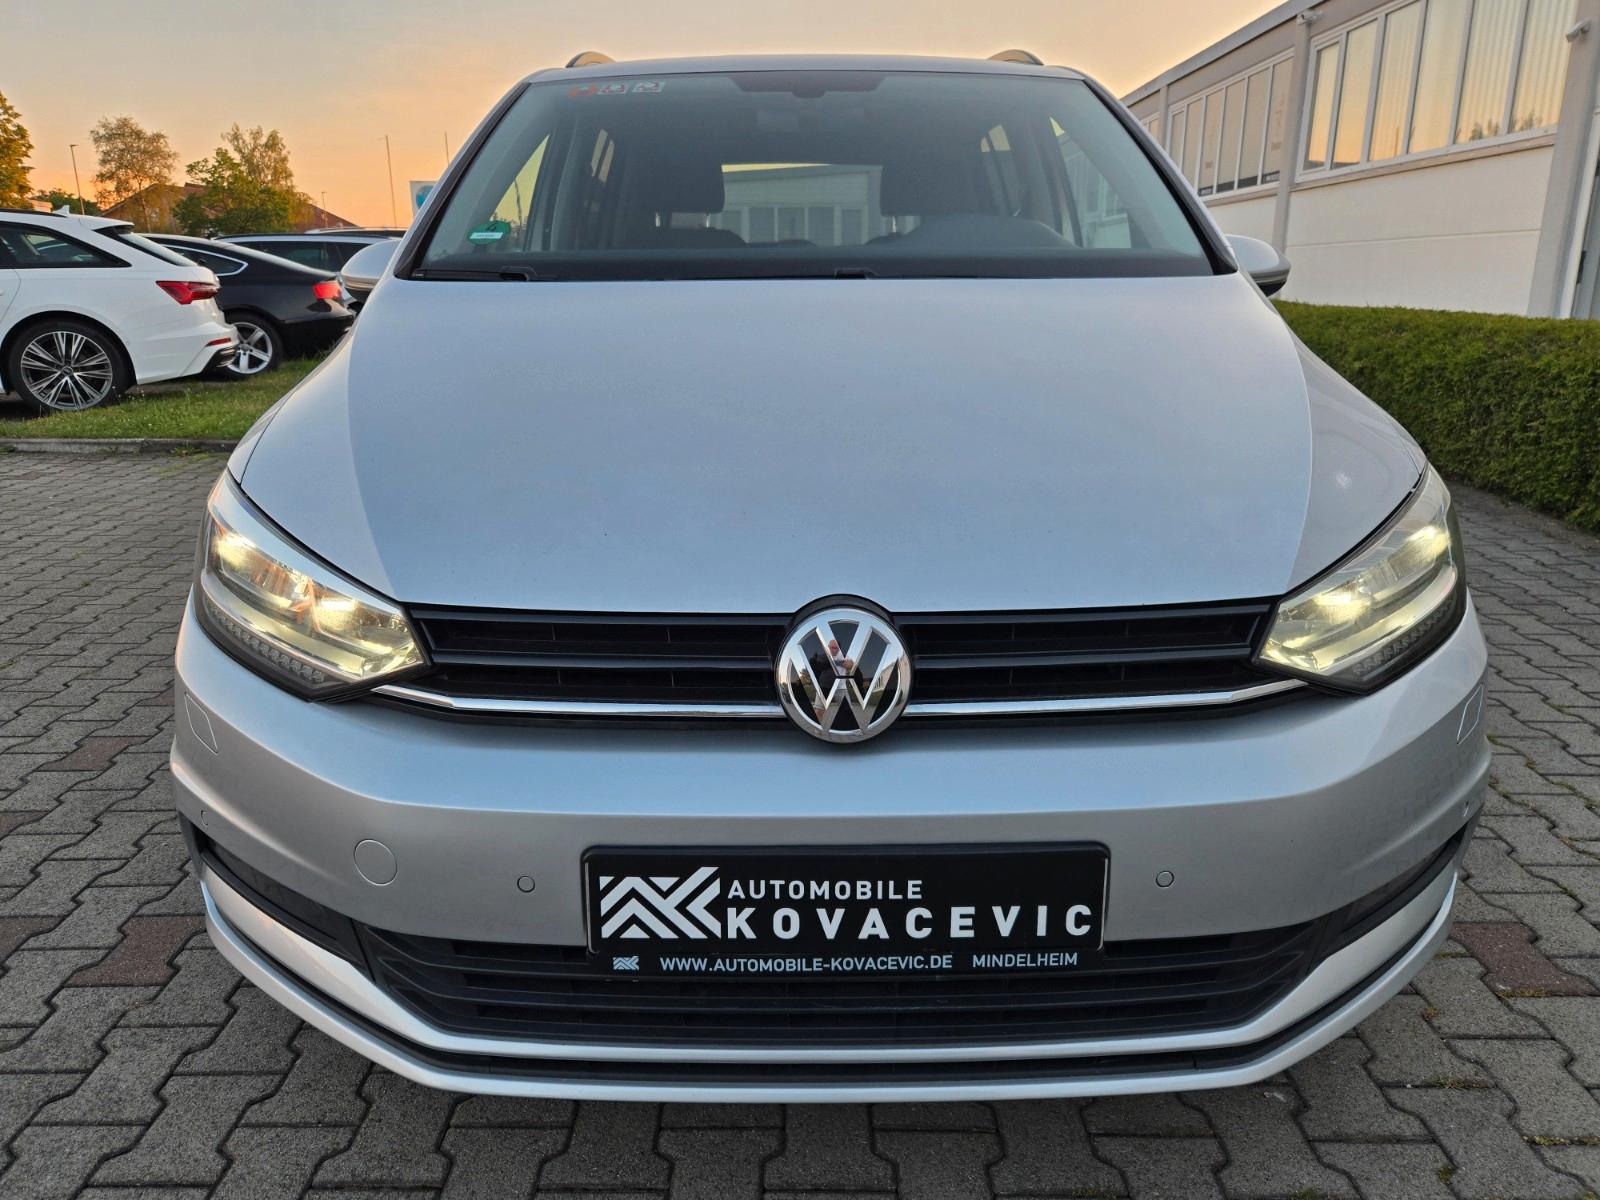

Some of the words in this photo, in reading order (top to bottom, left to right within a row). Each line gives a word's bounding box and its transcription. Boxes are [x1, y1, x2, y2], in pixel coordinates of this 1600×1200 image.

[777, 608, 911, 743] VW
[727, 879, 923, 900] AUTOMOBILE
[727, 905, 1092, 940] KOVACEVIC
[659, 954, 953, 972] WWW.AUTOMOBILE-KOVACEVIC.DE
[971, 952, 1078, 968] MINDELHEIM
